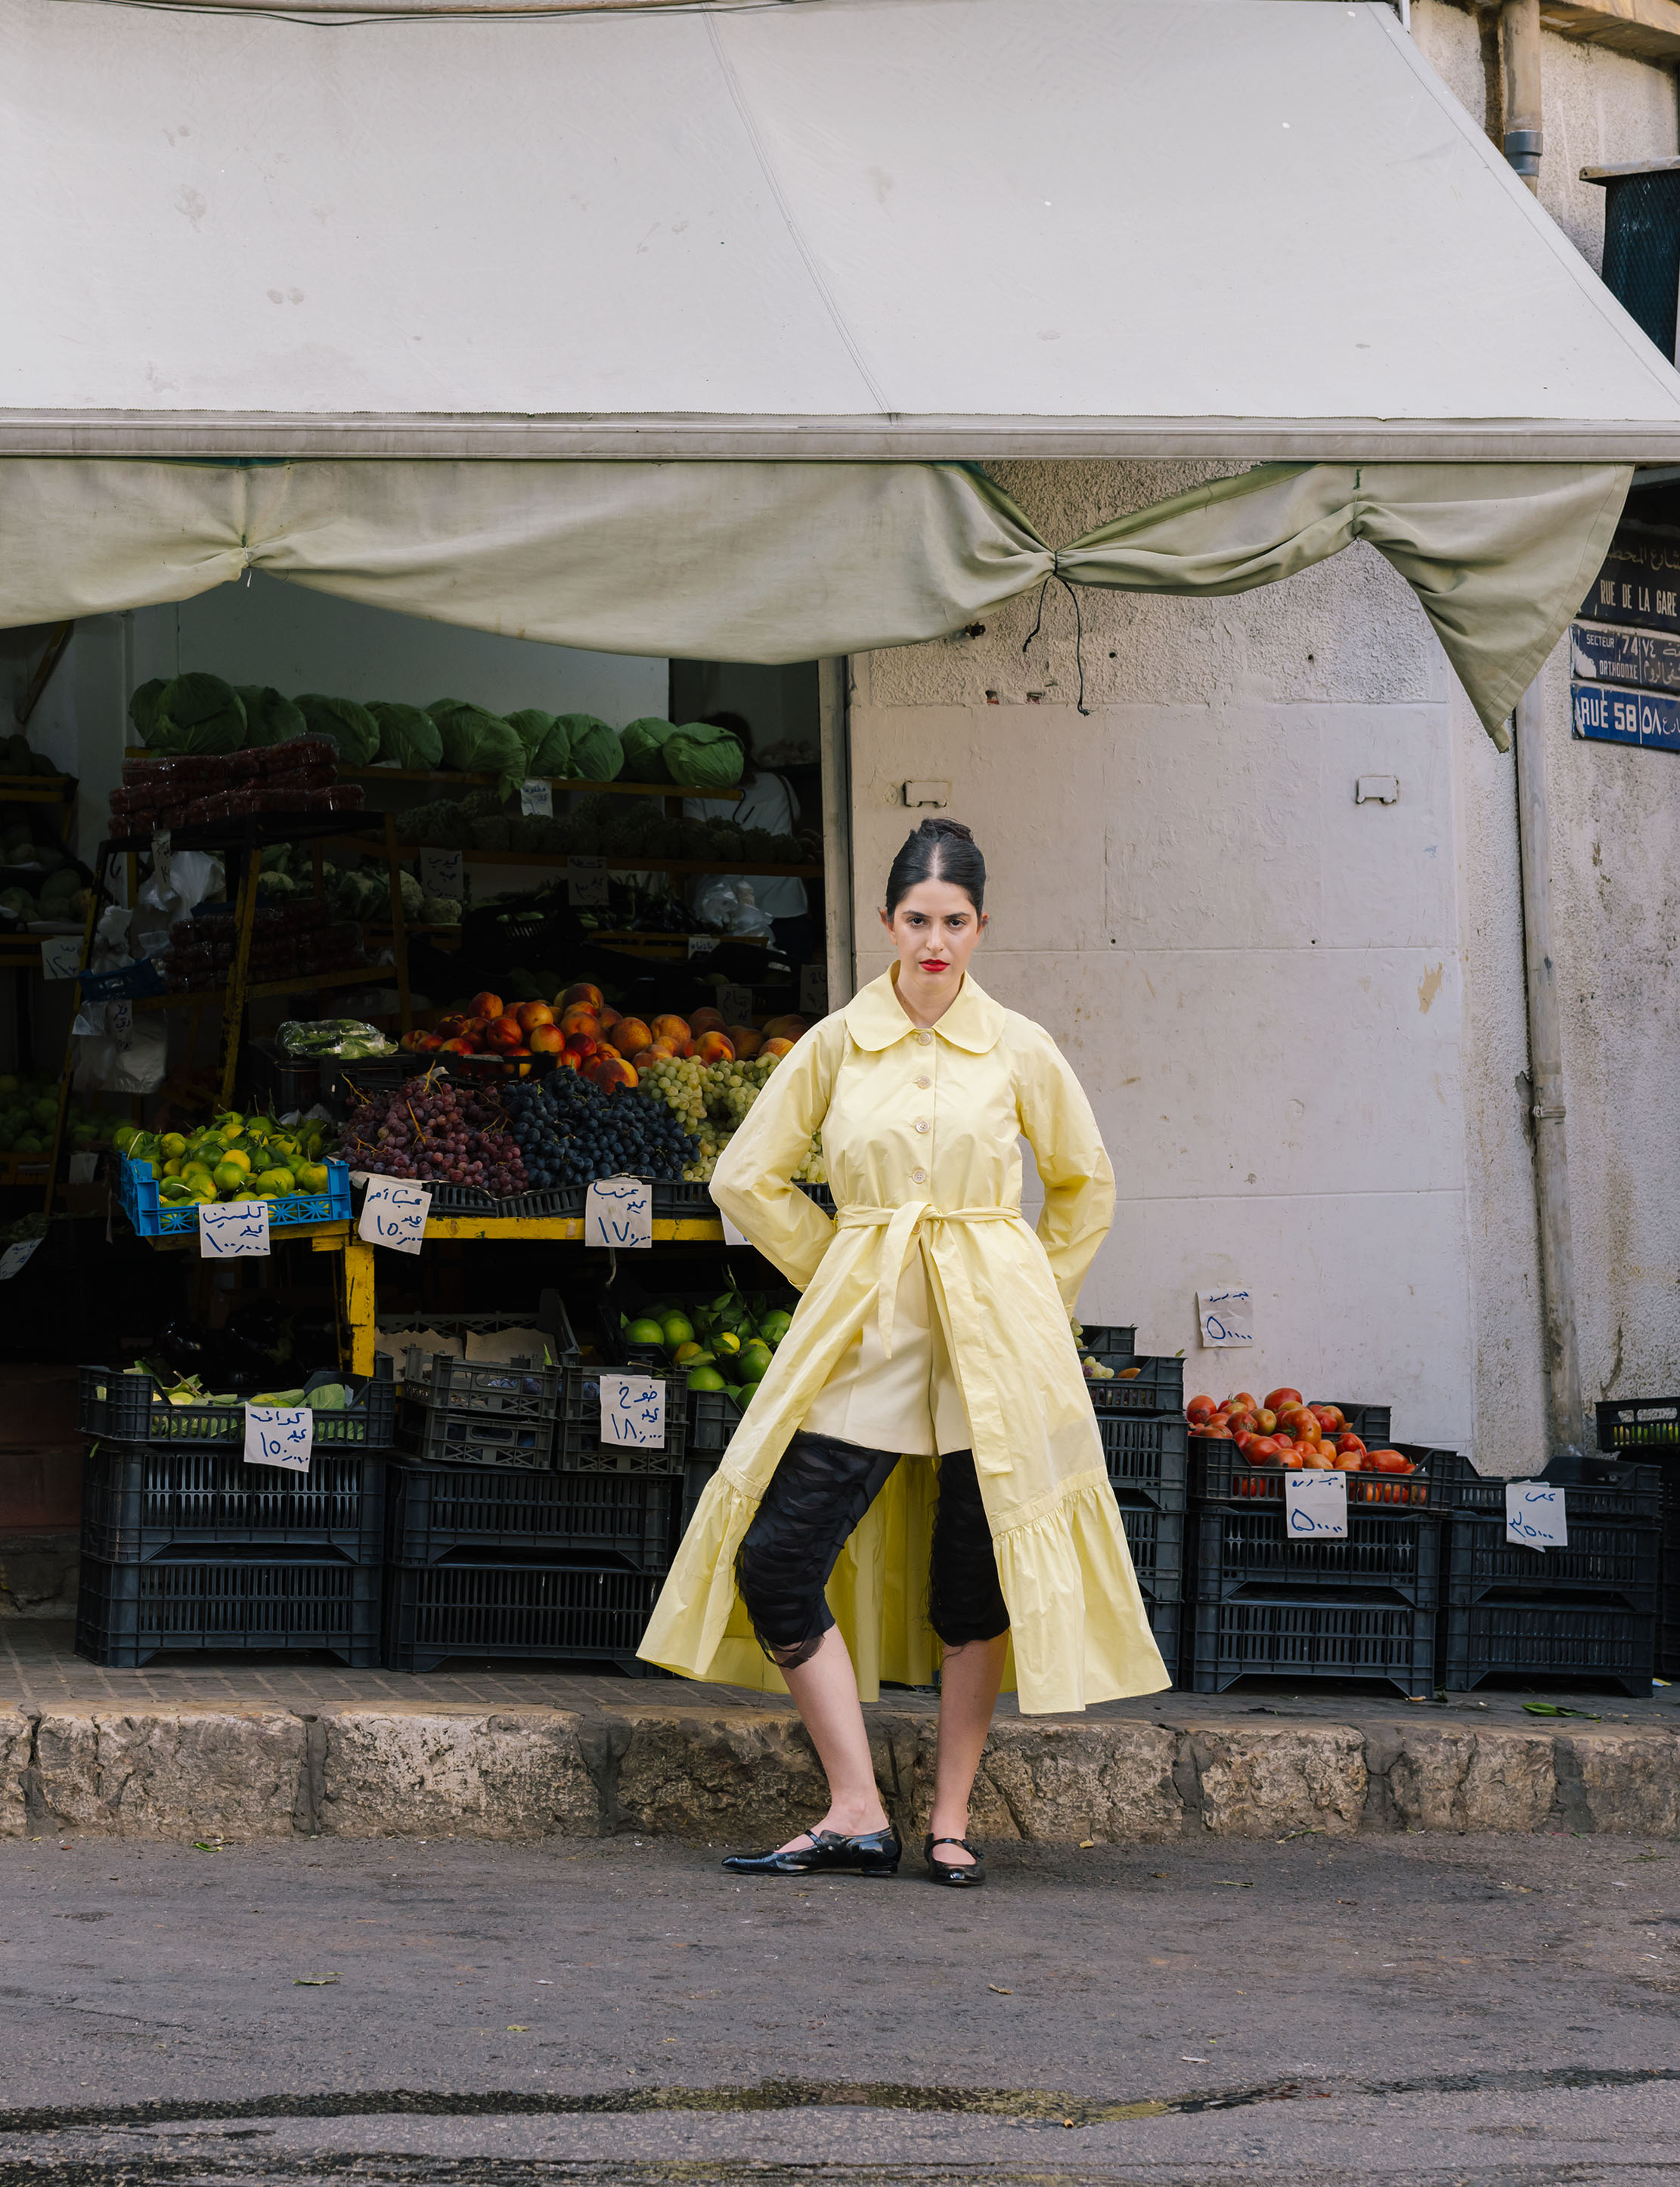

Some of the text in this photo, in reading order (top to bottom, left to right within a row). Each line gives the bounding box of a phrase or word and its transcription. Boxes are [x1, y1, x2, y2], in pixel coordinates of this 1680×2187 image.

[1607, 540, 1647, 565] المحط
[1600, 579, 1677, 617] RUE DE LA GARE
[1586, 633, 1638, 656] SECTEUR 74
[1599, 660, 1638, 680] ORTHODOXE
[1581, 697, 1637, 733] RUE 58
[1663, 717, 1680, 736] ارع
[594, 1182, 639, 1200] عنب
